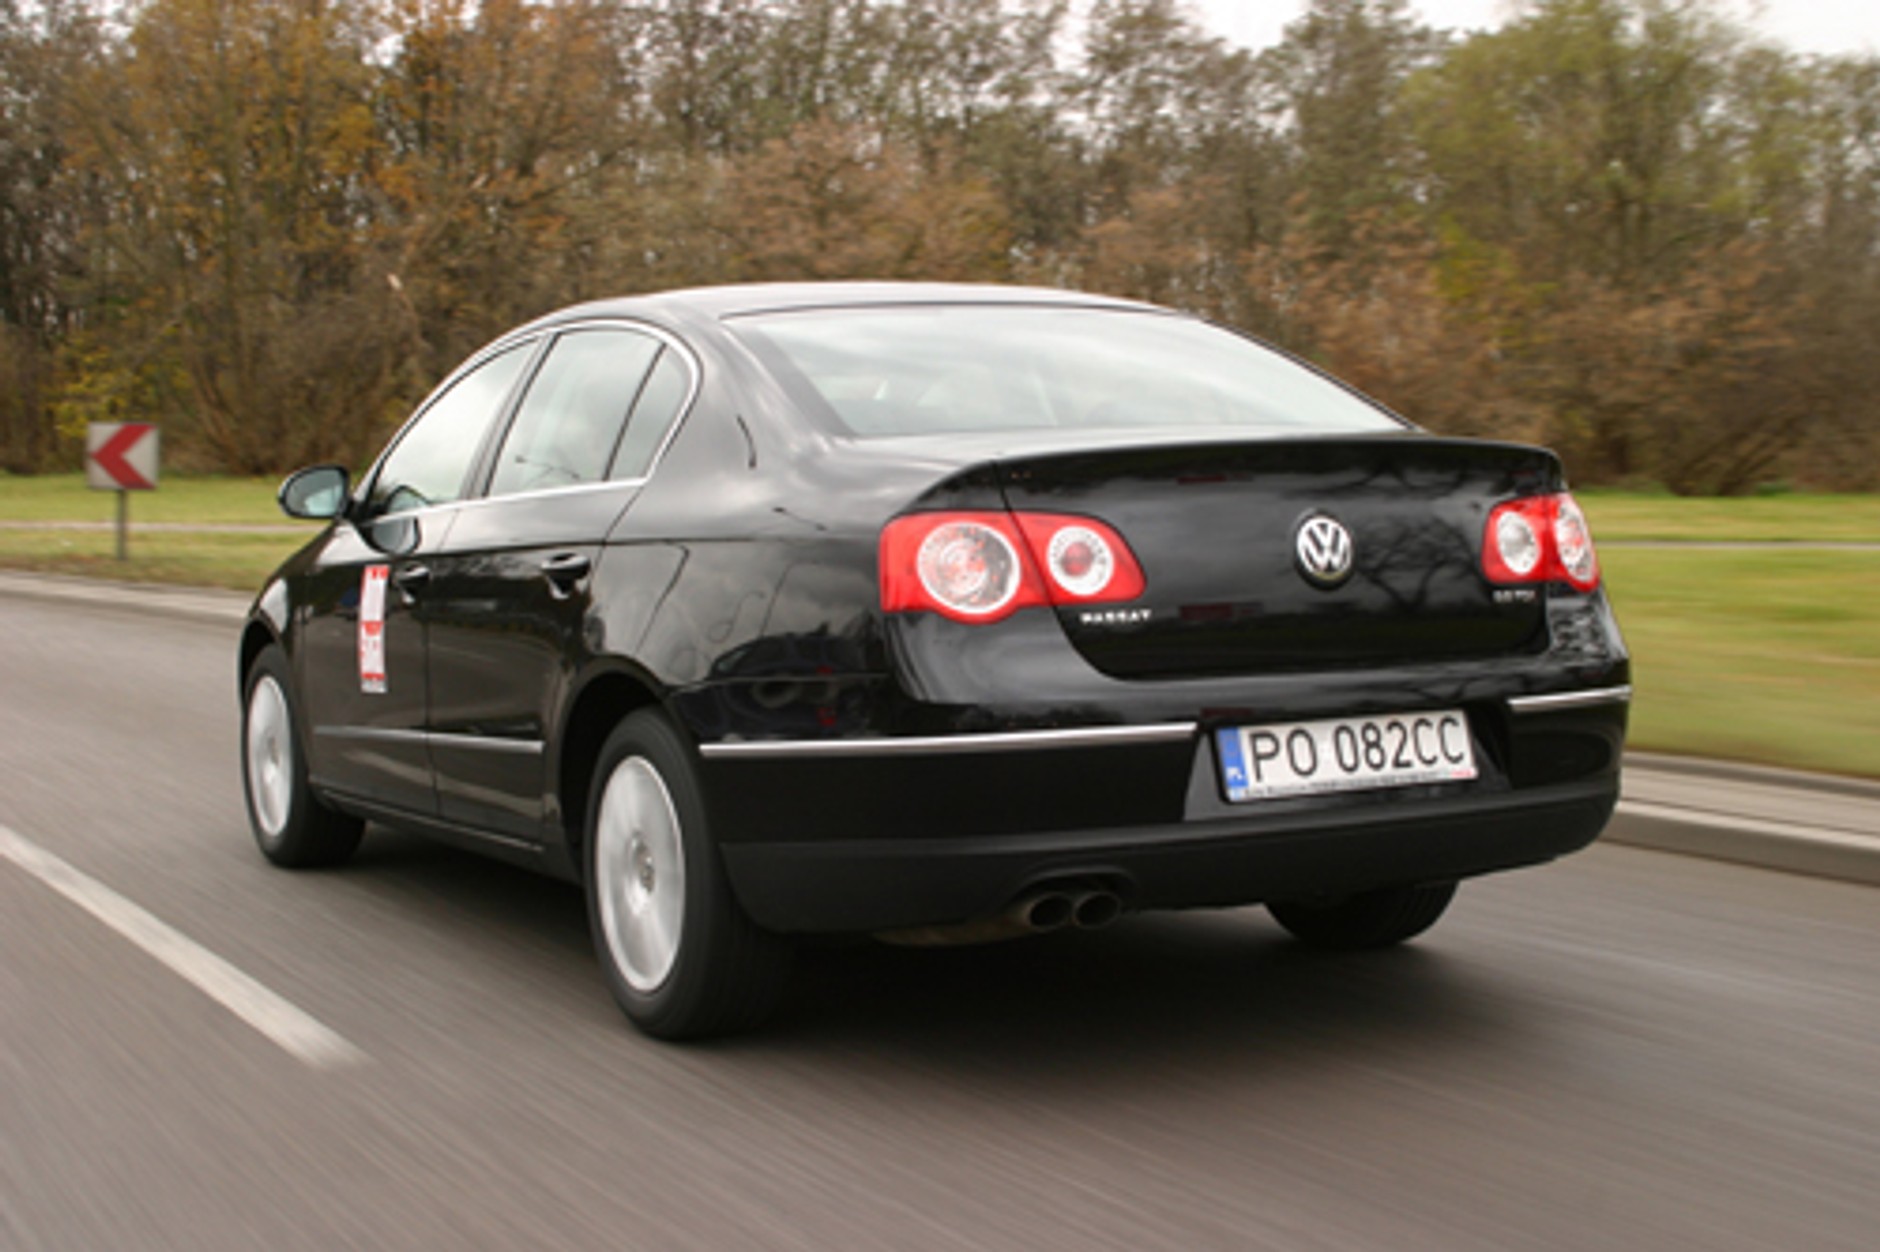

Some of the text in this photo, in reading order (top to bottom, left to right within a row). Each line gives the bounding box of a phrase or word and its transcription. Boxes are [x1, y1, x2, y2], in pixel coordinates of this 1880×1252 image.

[1297, 515, 1351, 577] VW
[1248, 715, 1464, 782] PO 082CC
